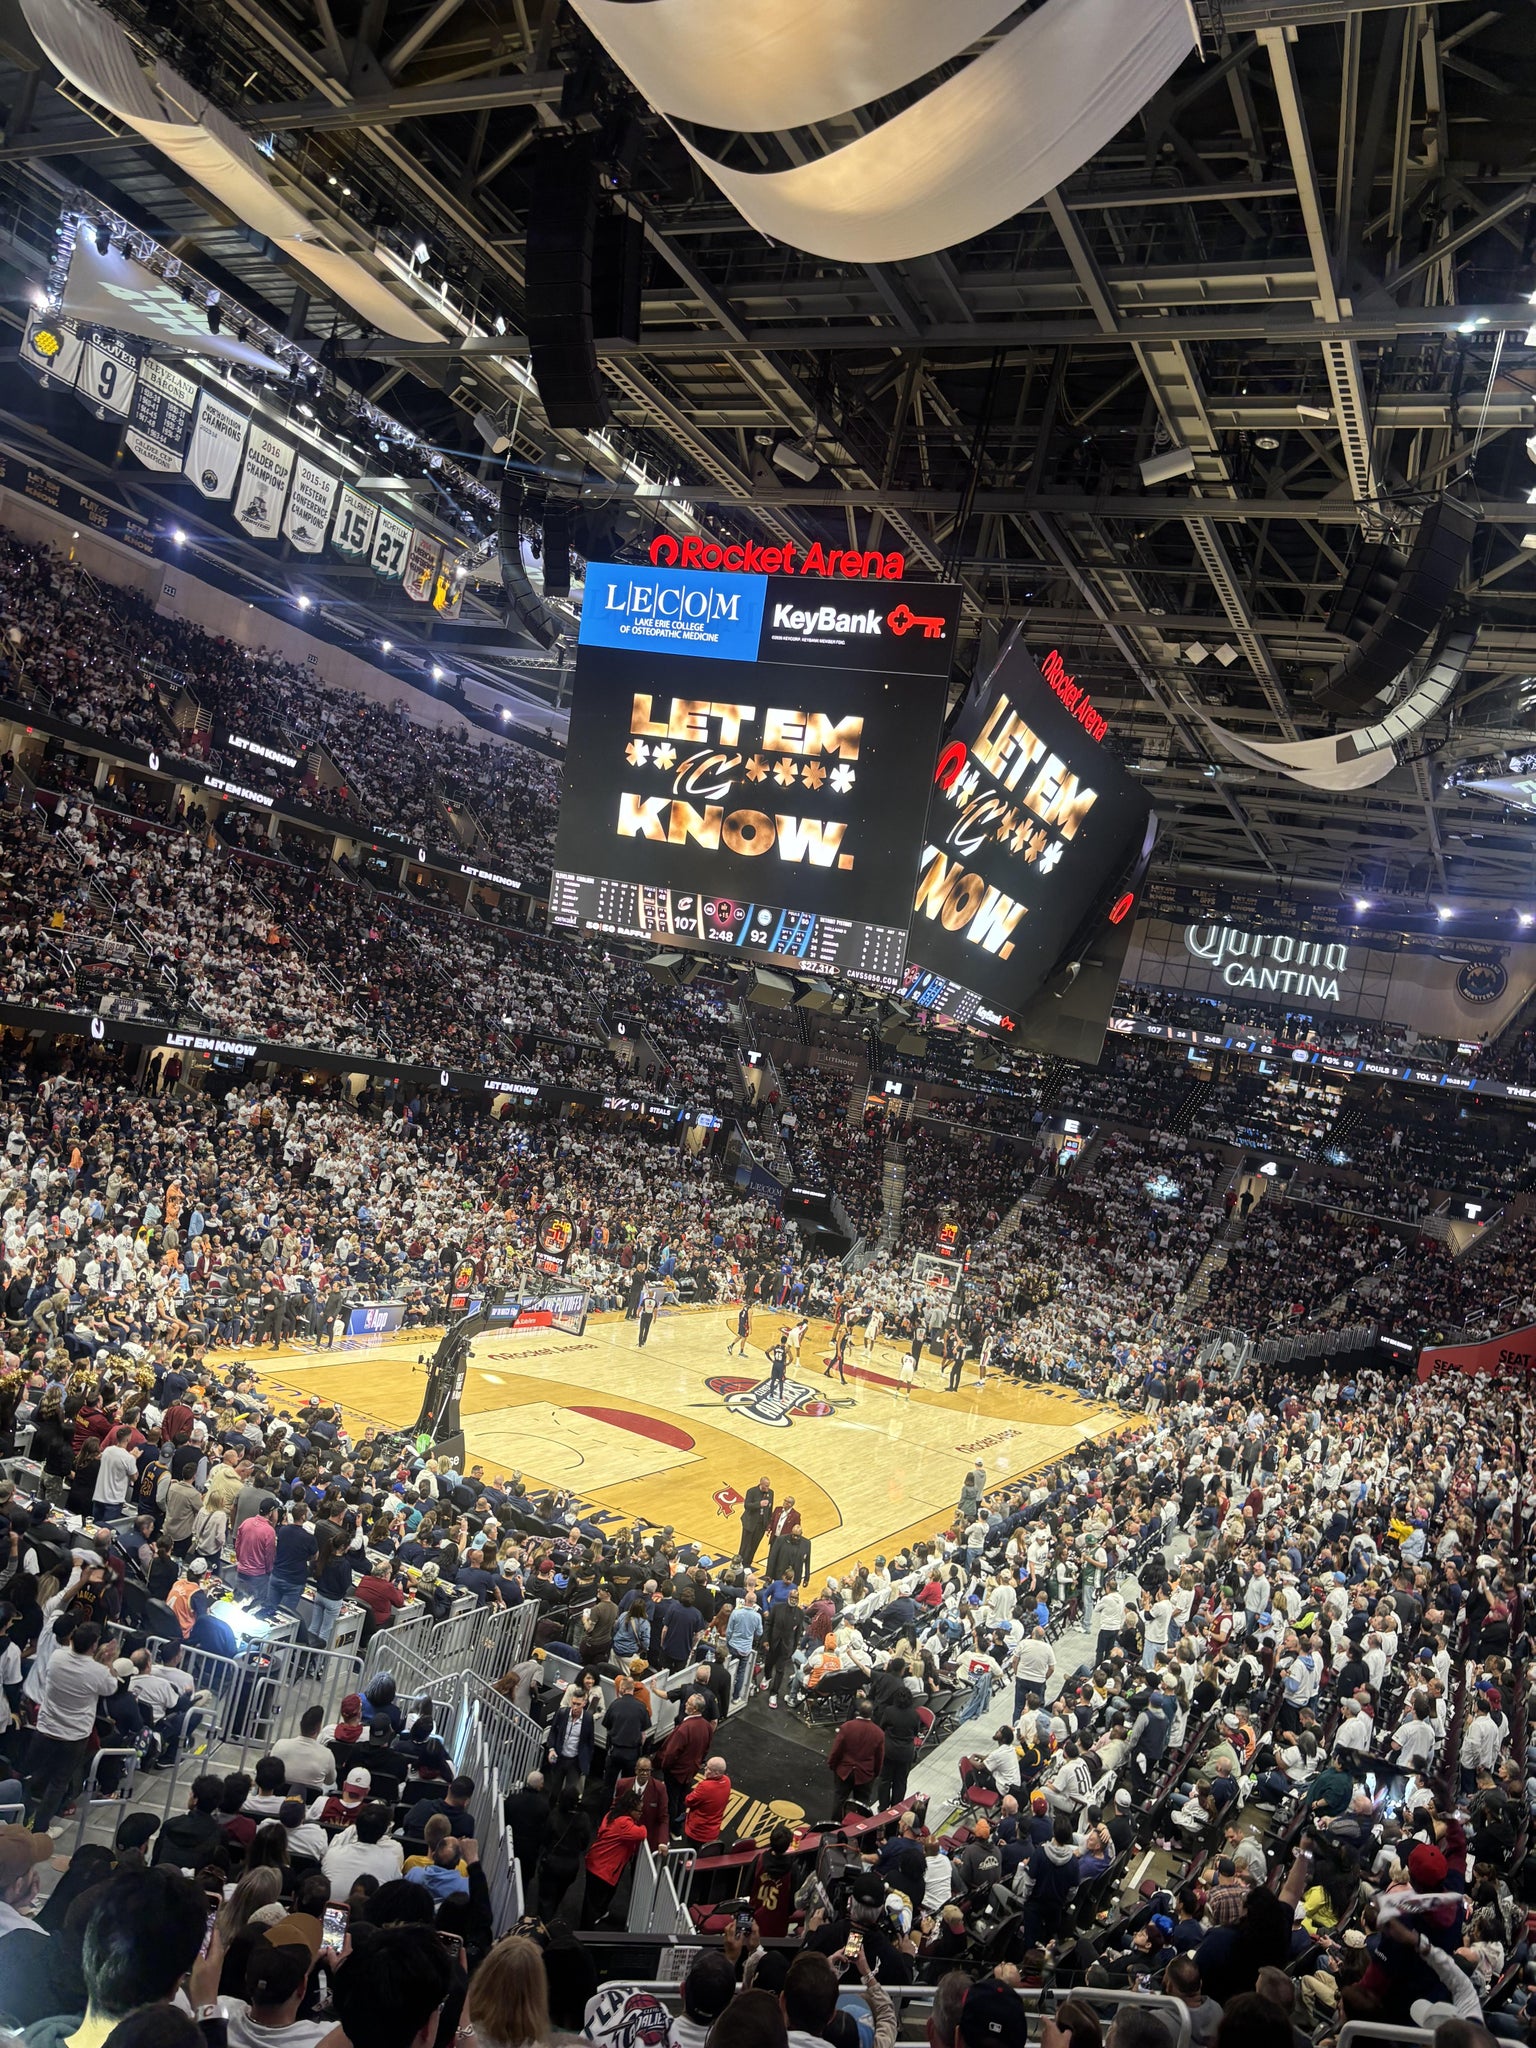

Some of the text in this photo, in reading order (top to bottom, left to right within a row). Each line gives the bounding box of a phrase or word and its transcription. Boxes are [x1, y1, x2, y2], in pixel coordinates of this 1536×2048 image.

[97, 281, 202, 336] 4TH
[141, 285, 237, 336] THE
[97, 361, 118, 400] 9
[144, 358, 195, 396] CLEVELAND
[149, 372, 186, 400] BARONS
[201, 410, 241, 442] CHAMPIONS
[262, 440, 281, 458] 2016
[248, 448, 289, 479] CALDER CUP
[246, 461, 285, 492] CHAMPIONS
[301, 468, 331, 493] 2015-16
[293, 491, 328, 520] CONFERENCE
[300, 482, 327, 506] WESTERN
[291, 503, 324, 530] CHAMPIONS
[340, 509, 368, 549] 15
[376, 532, 404, 572] 27
[681, 535, 905, 579] Rocket Arena
[634, 617, 705, 632] LAKE ERIE COLLEGE
[773, 603, 883, 635] KeyBank
[620, 624, 719, 642] OF OSTEOPATHIC MEDICINE
[1046, 658, 1109, 742] Rocket Arena
[630, 693, 864, 761] LET EM
[228, 734, 298, 768] LET EM KNOW
[970, 693, 1098, 841] LET EM
[203, 775, 274, 807] LET EM KNOW
[617, 792, 855, 871] KNOW.
[460, 864, 522, 889] LET EM KNOW
[617, 926, 652, 939] RAFFLE
[674, 916, 697, 931] 107
[708, 928, 733, 943] 2:48
[750, 929, 768, 944] 92
[1184, 925, 1349, 973] Corona
[800, 960, 836, 975] $27,314
[846, 969, 898, 986] CAVS5050.COM
[1223, 962, 1340, 1002] CANTINA
[975, 1005, 1002, 1025] KeyBank
[1147, 1025, 1161, 1034] 107
[1204, 1035, 1221, 1044] 2:48
[166, 1033, 258, 1057] LET EM KNOW
[1260, 1045, 1273, 1054] 92
[747, 1050, 762, 1064] T
[825, 1055, 859, 1068] LITEHOUSE
[1321, 1055, 1340, 1066] FG%
[1365, 1064, 1390, 1074] FOULS
[1416, 1072, 1437, 1082] TOL 2
[484, 1080, 539, 1096] LET EM KNOW
[884, 1080, 903, 1095] H
[1507, 1086, 1530, 1097] THE
[630, 1102, 691, 1120] 10 STEALS 6
[1064, 1118, 1080, 1133] E
[1260, 1161, 1277, 1176] 4
[1464, 1202, 1482, 1219] T
[554, 1295, 583, 1312] PLAYOFFS
[371, 1309, 388, 1331] App
[500, 1343, 599, 1361] Rocket Arena
[1498, 1349, 1531, 1367] SEAT
[960, 1428, 1022, 1453] Rocket Arena
[1074, 1764, 1093, 1795] 80
[757, 1884, 779, 1910] 45
